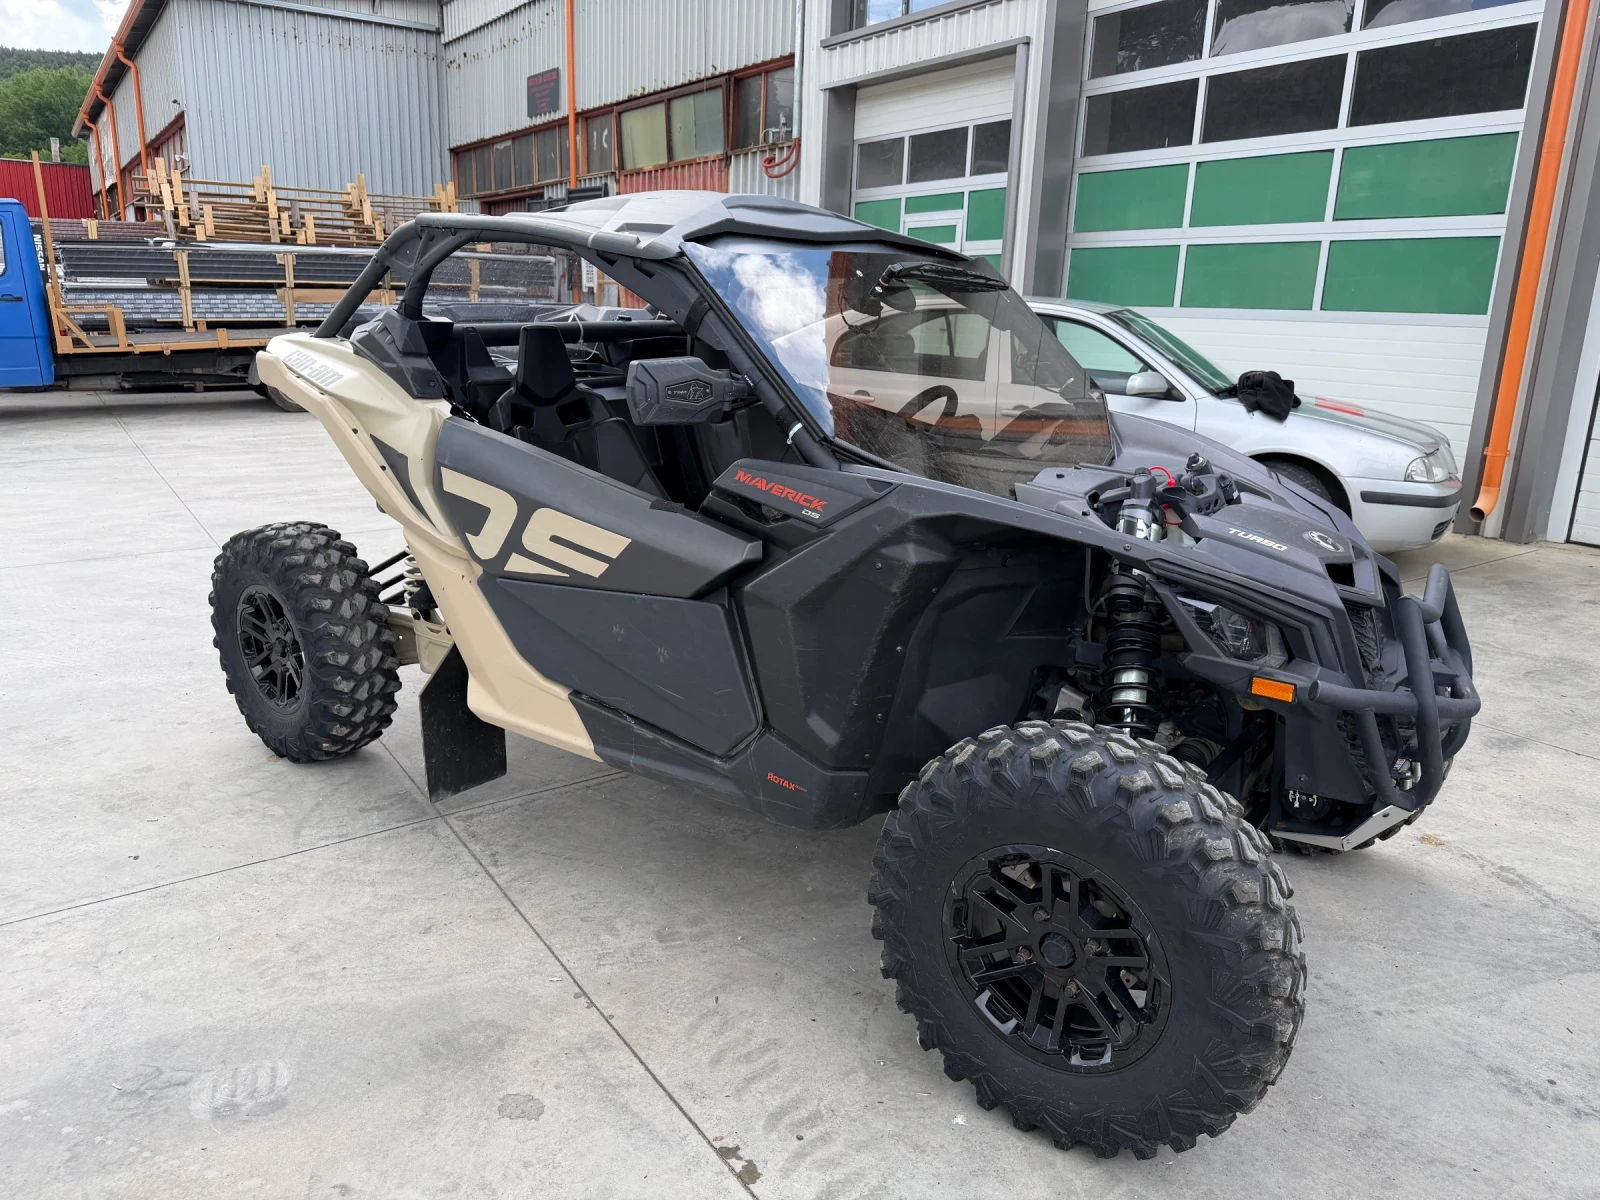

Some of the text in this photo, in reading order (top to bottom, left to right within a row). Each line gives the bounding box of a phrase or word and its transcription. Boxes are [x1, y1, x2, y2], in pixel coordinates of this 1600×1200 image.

[33, 234, 46, 271] NISSAN
[734, 469, 828, 512] MAVERICK
[440, 466, 632, 579] DS
[801, 508, 821, 519] DS
[1228, 527, 1288, 552] TURBO
[767, 772, 796, 791] ROTAX
